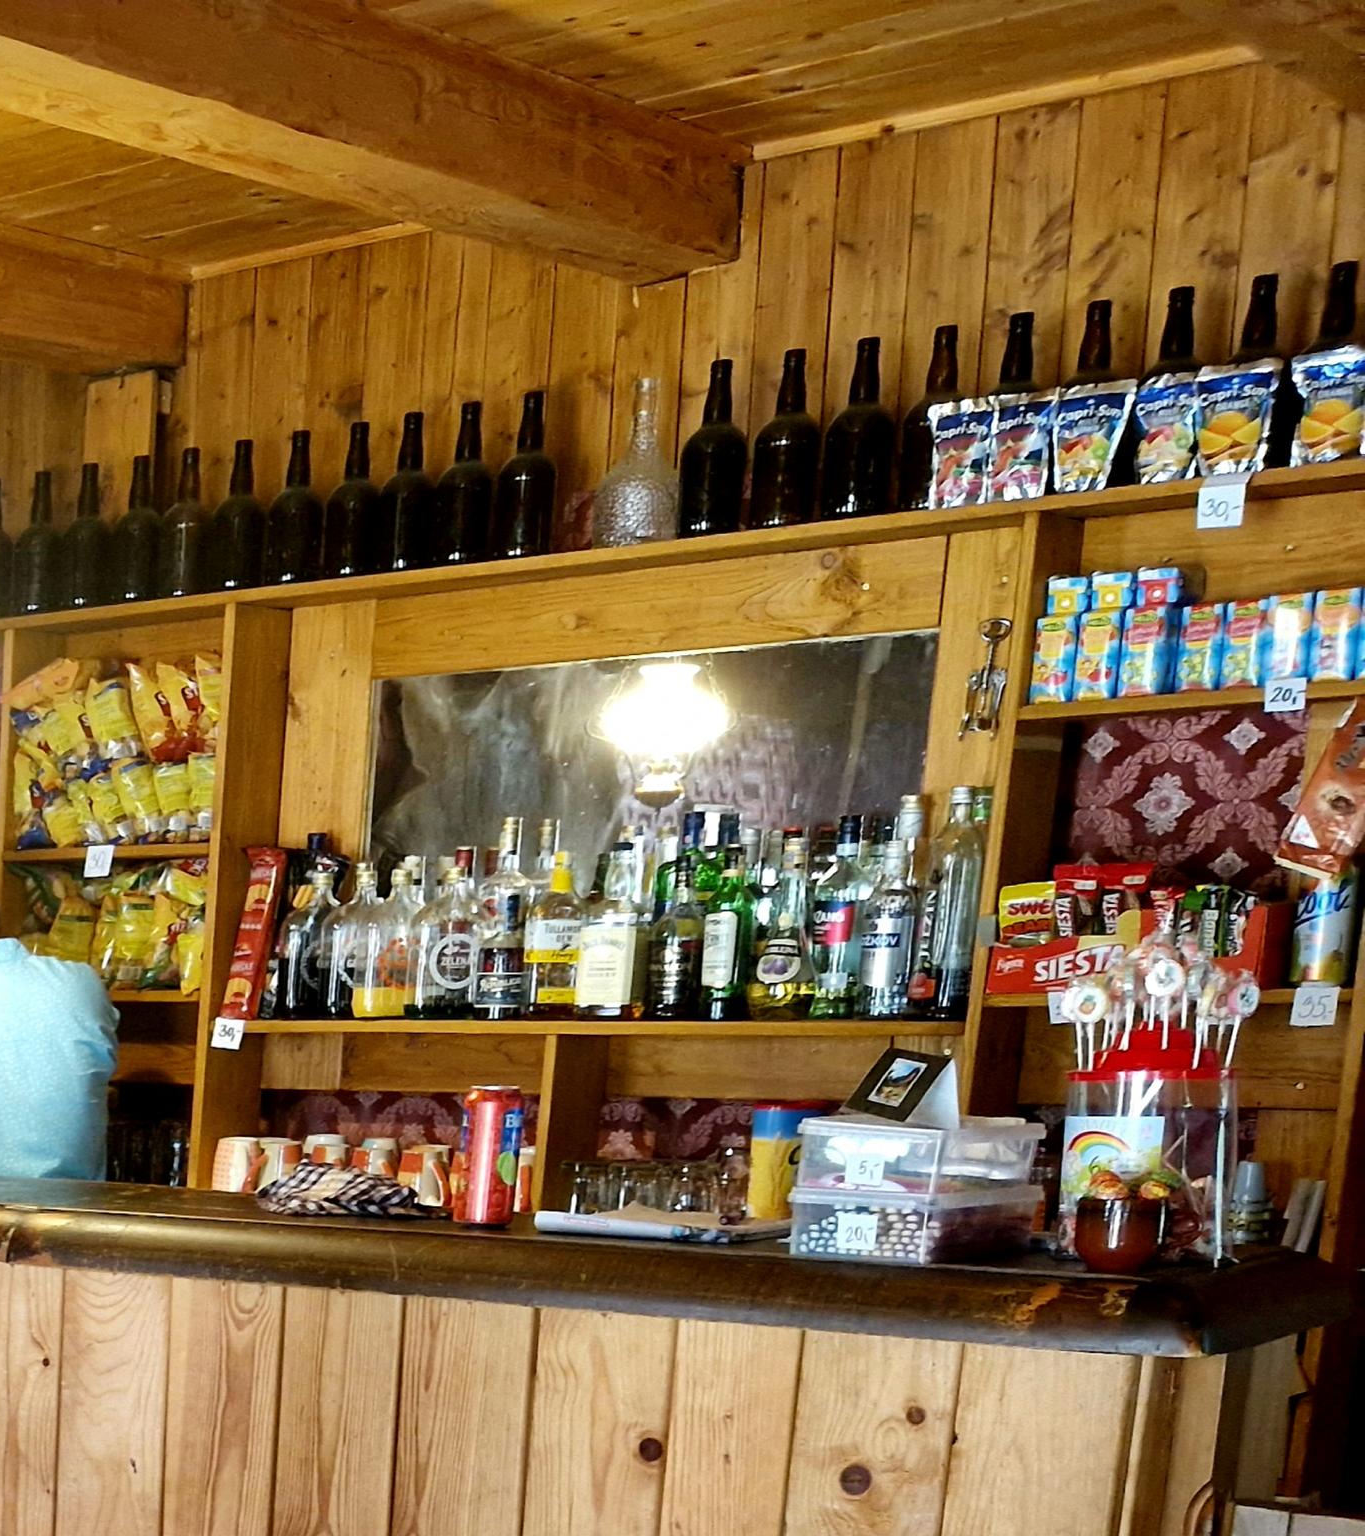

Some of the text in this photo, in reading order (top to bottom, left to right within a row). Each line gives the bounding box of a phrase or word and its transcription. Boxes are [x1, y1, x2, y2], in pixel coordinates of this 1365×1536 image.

[1200, 379, 1268, 407] Capri-Sun
[1058, 400, 1122, 425] Capri-Sun
[1201, 498, 1241, 521] 30,-
[1270, 686, 1306, 705] 20,-
[1008, 901, 1052, 915] SWE
[1055, 897, 1073, 937] SIESTA
[1102, 892, 1121, 934] SIESTA
[544, 924, 581, 934] TULLAMOR
[1033, 944, 1125, 982] SIESTA
[845, 1226, 875, 1244] 20,-
